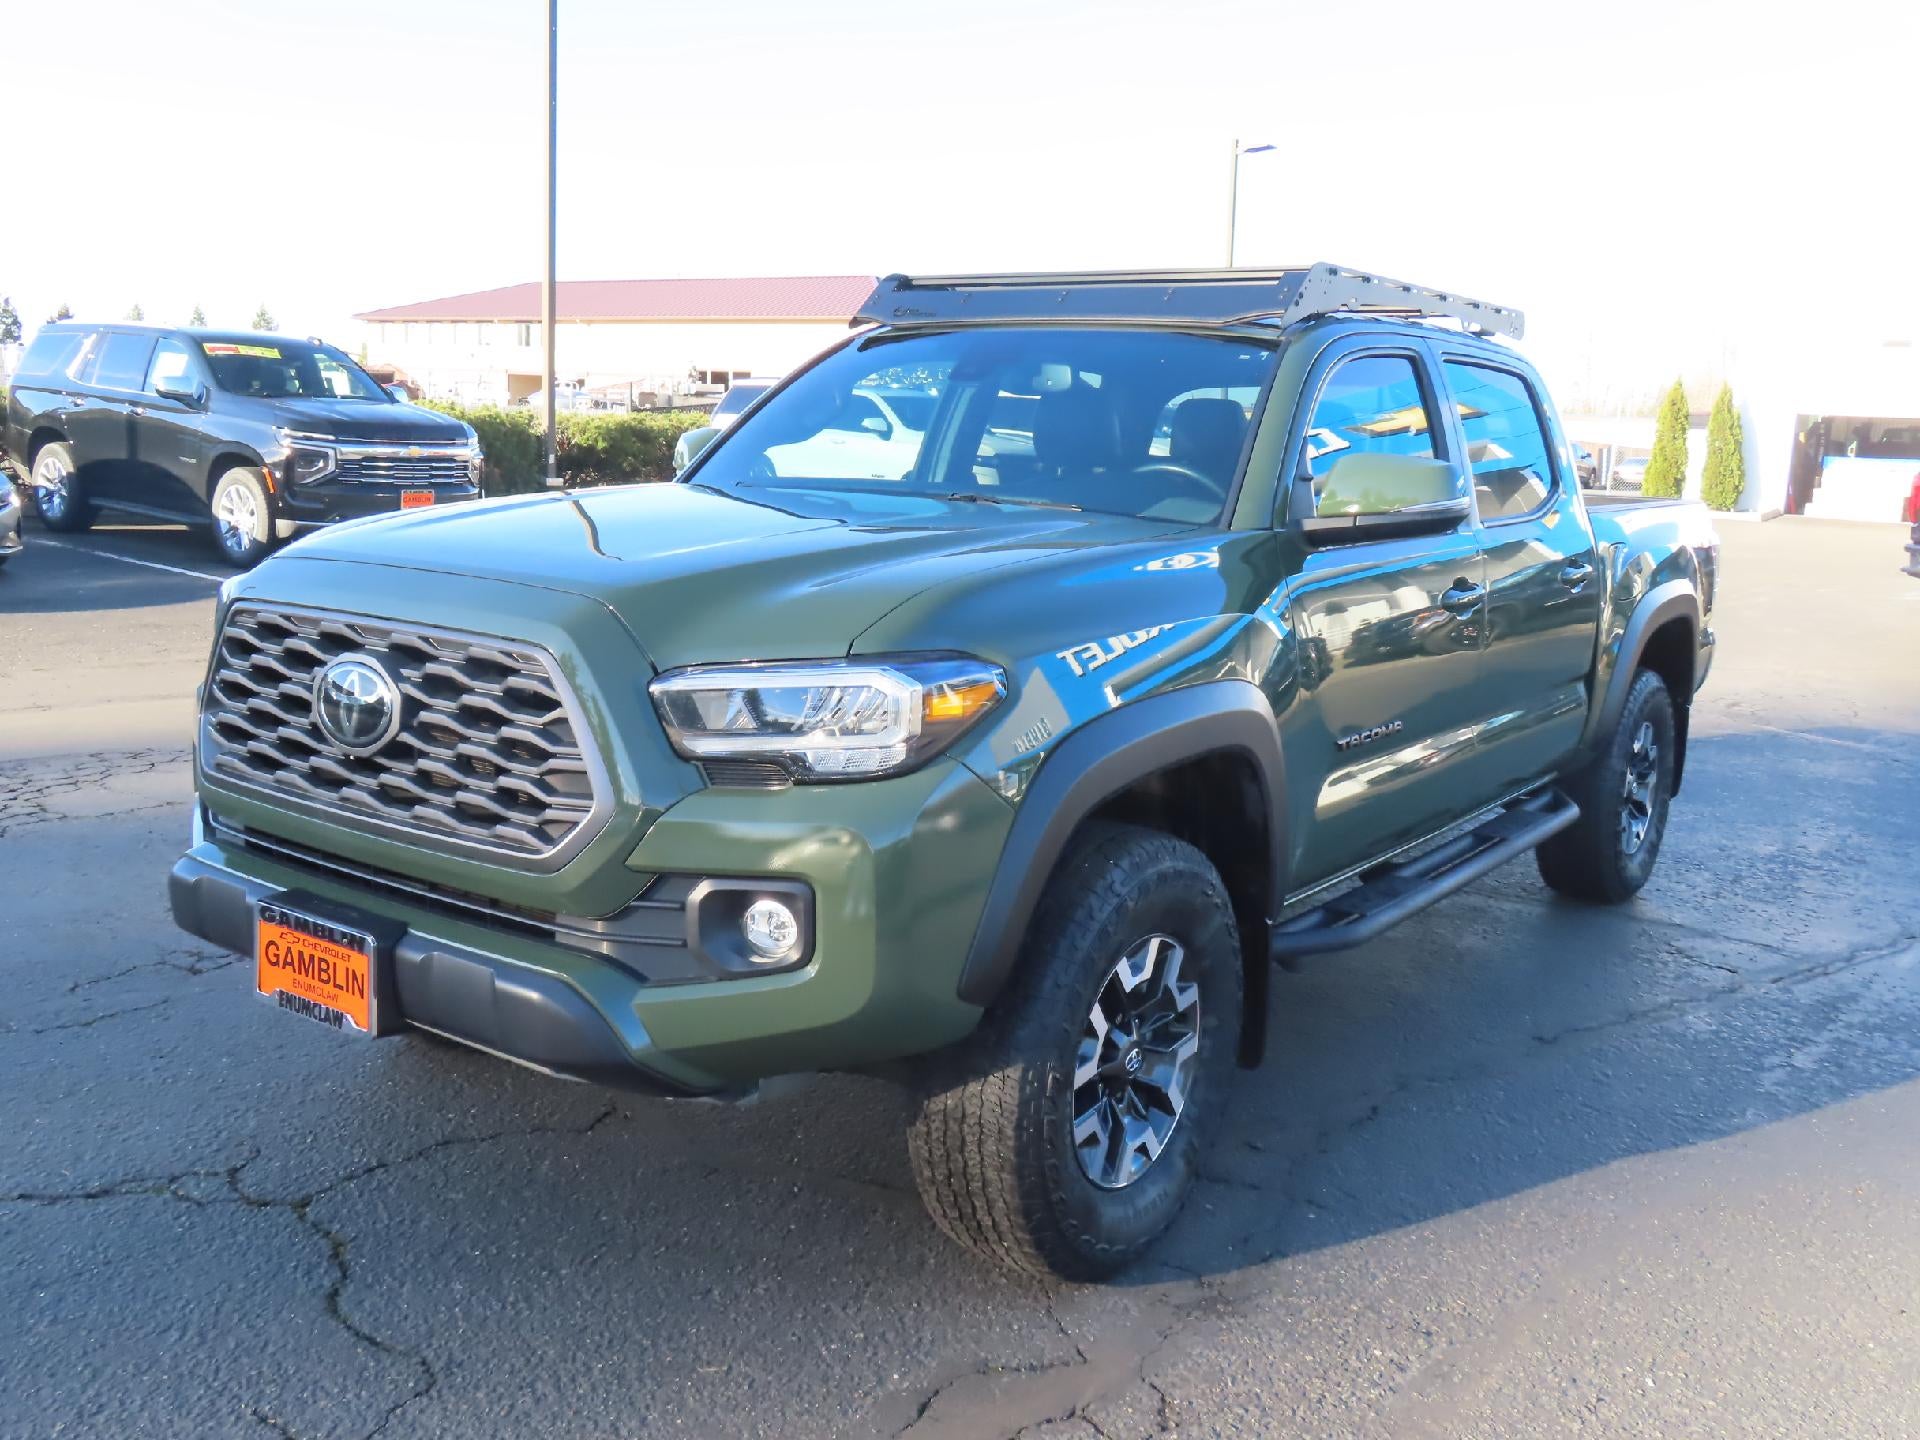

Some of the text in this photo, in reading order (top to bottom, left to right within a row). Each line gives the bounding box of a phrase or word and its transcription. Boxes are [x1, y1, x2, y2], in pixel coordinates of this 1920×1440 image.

[1336, 720, 1402, 751] TACOMA
[302, 937, 352, 963] CHEVROLET
[265, 939, 365, 999] GAMBLIN
[292, 978, 339, 1002] ENUMCLAW
[278, 989, 345, 1030] ENUMCLAW
